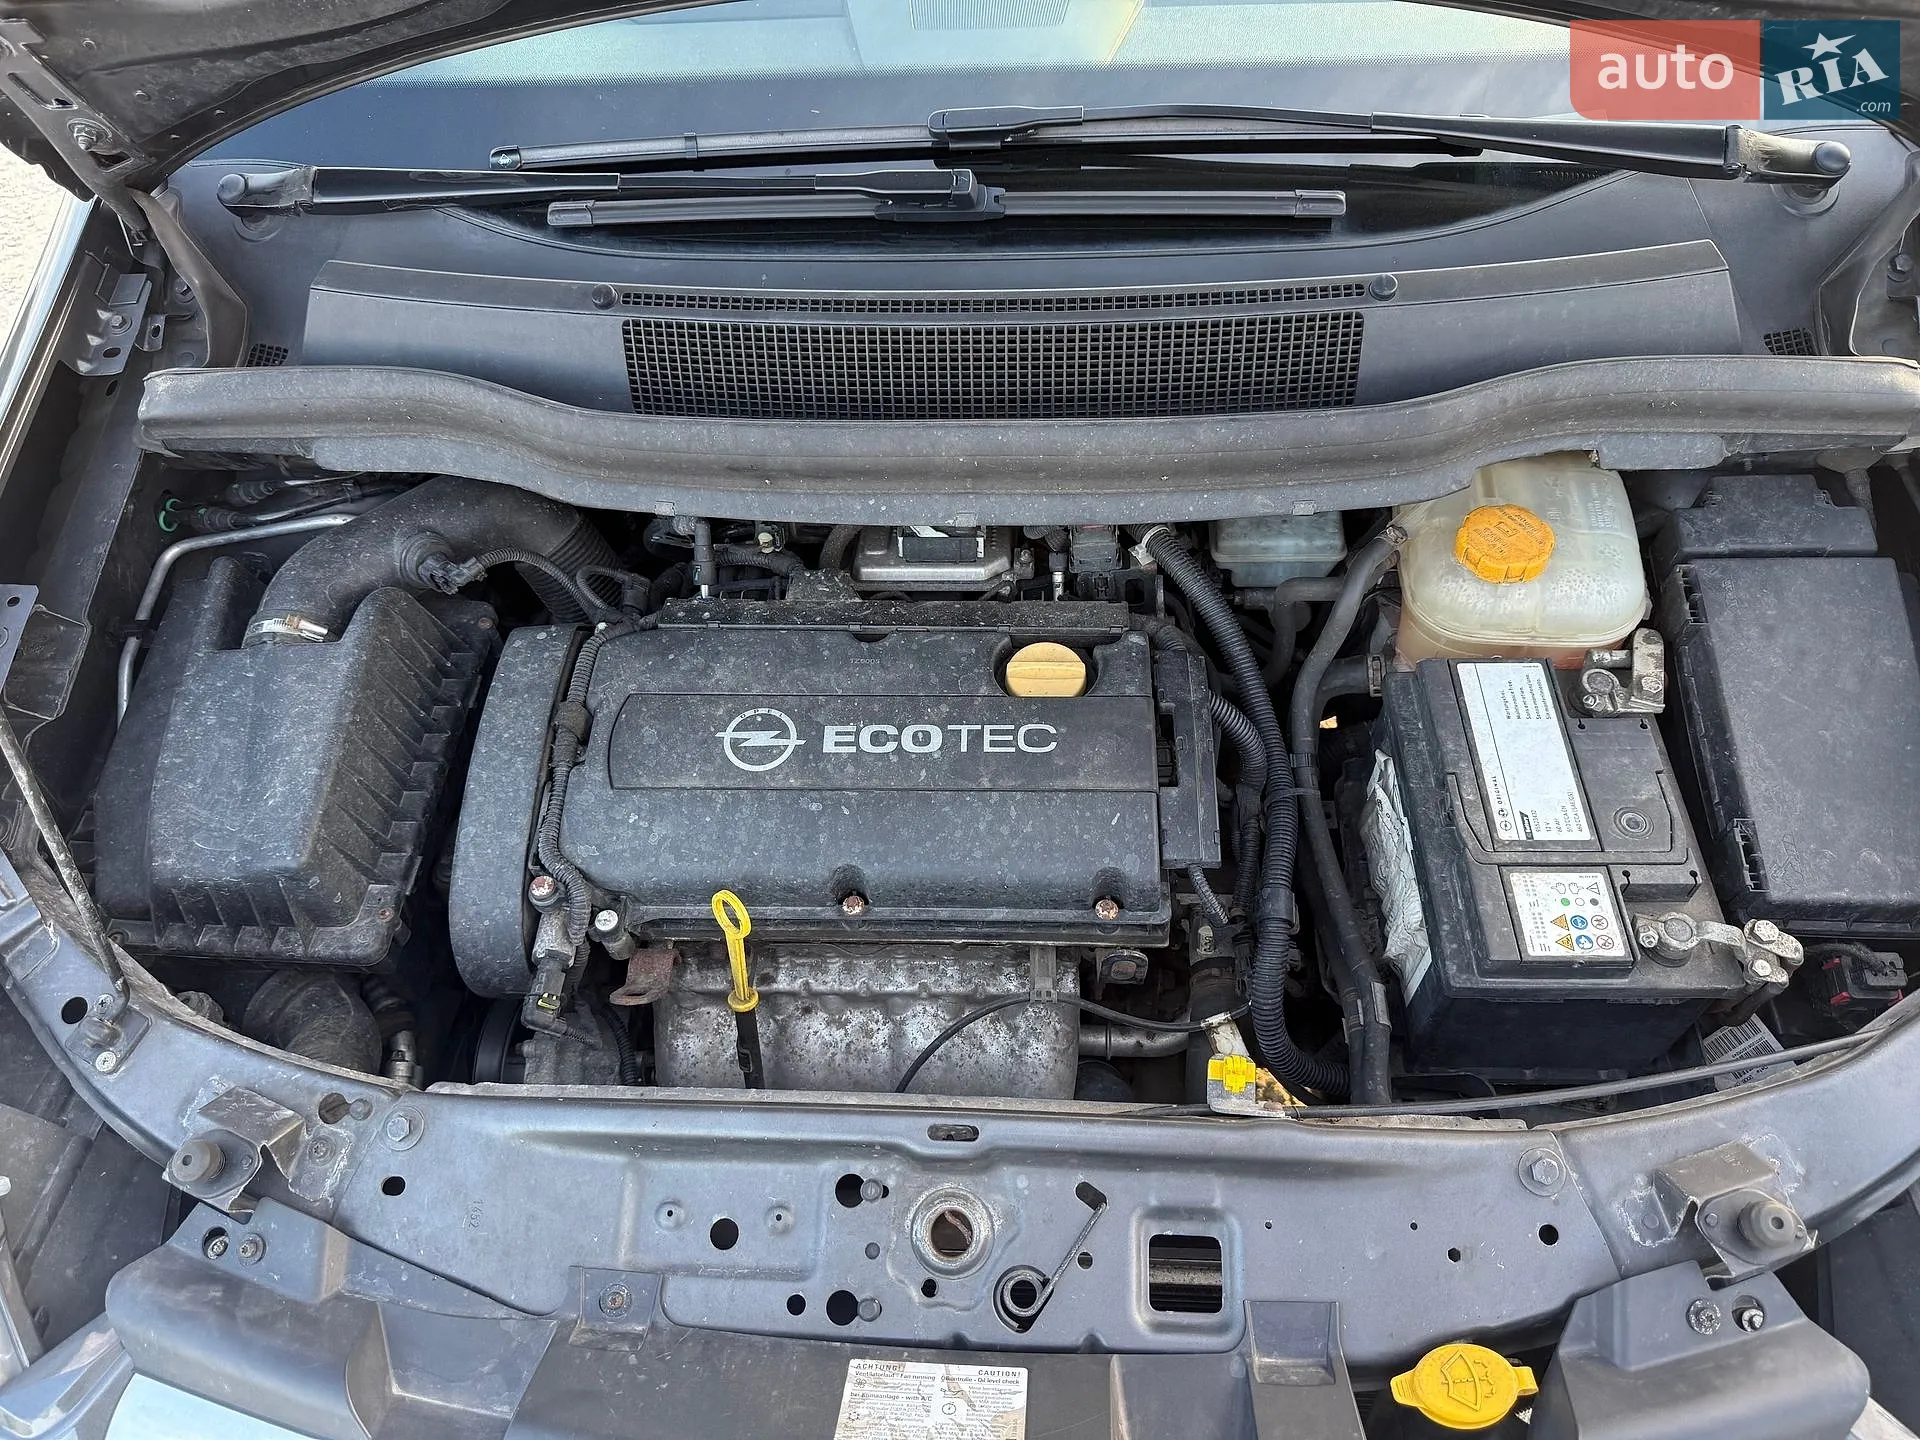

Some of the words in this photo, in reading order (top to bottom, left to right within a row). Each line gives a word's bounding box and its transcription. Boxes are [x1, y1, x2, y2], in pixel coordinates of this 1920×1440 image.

[739, 706, 787, 720] OPEL
[822, 723, 1058, 753] ECOTEC
[1492, 776, 1502, 804] ORIGINAL
